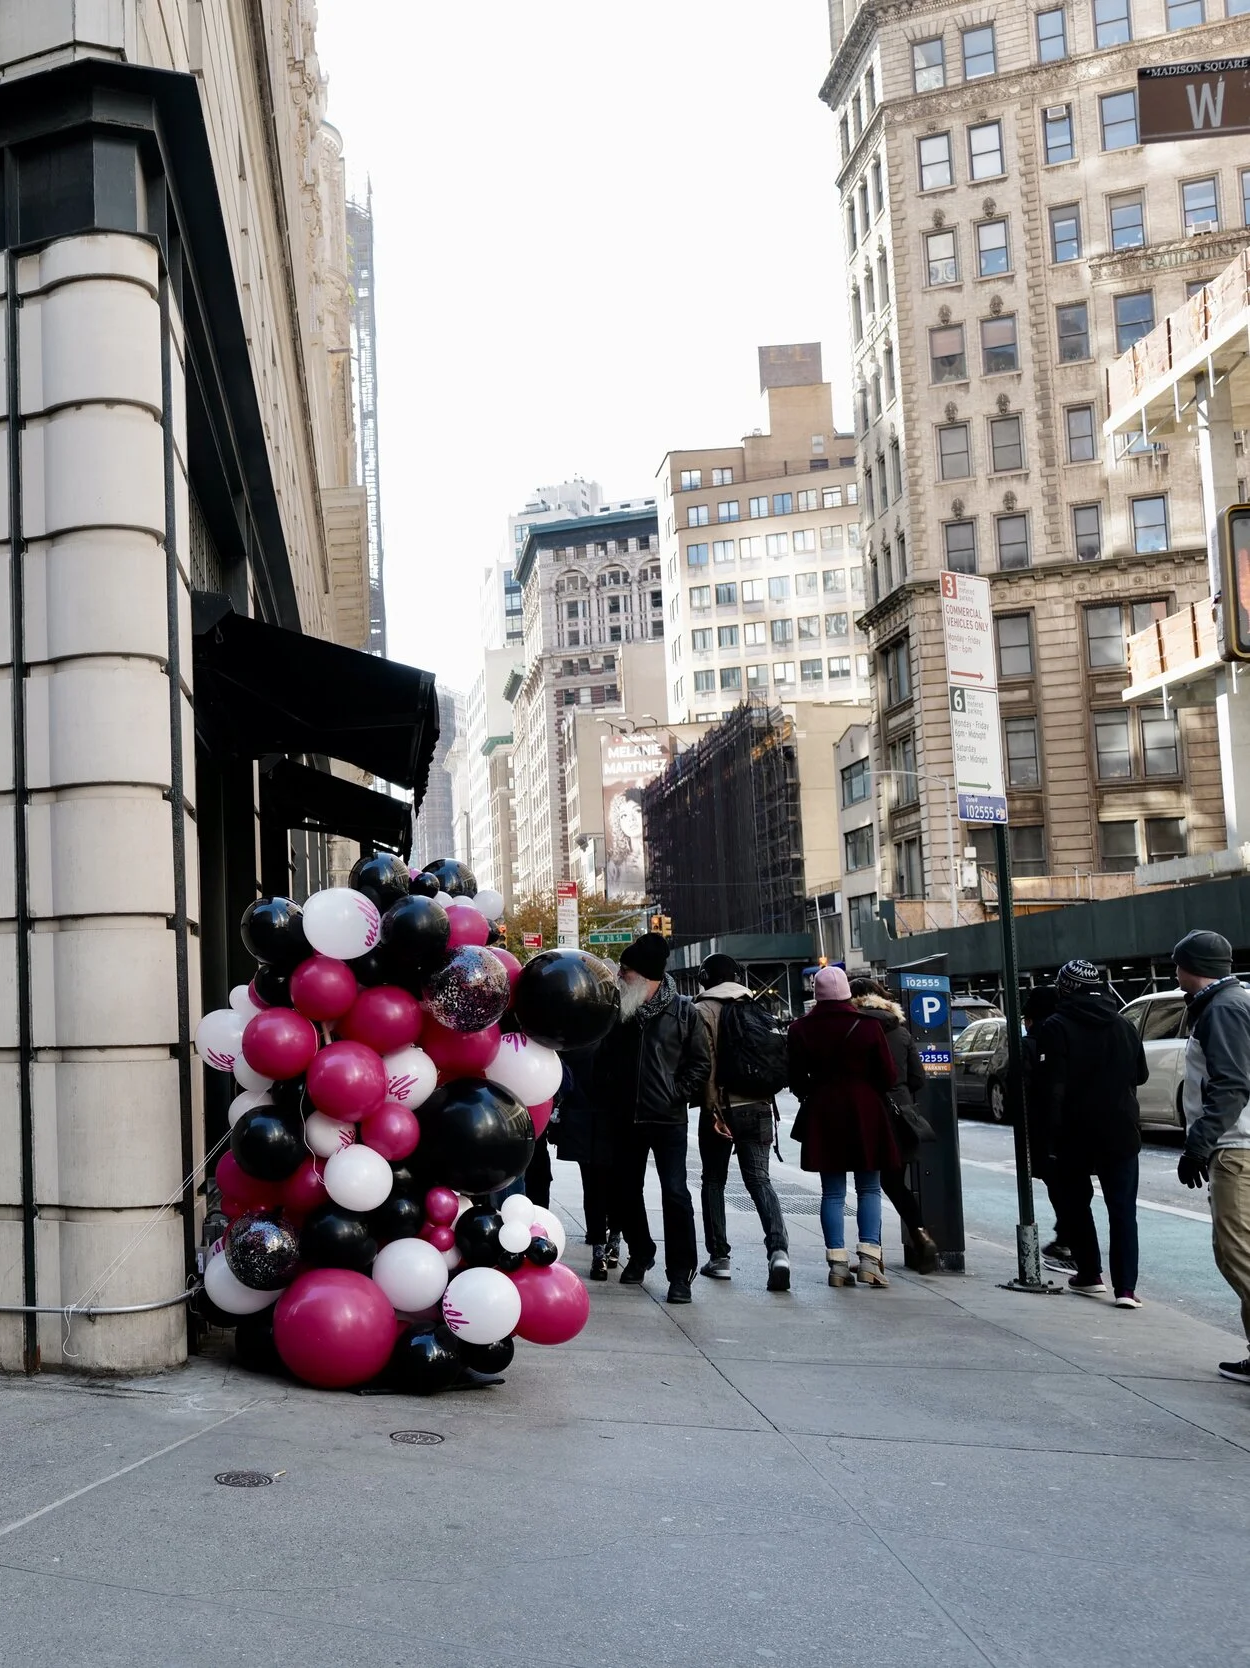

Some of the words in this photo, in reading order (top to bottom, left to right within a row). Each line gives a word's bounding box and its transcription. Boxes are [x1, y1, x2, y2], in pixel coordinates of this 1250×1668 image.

[1151, 64, 1202, 77] MADISON
[1204, 59, 1248, 72] SQUARE
[1186, 80, 1225, 129] W
[945, 575, 954, 597] 3
[945, 604, 982, 620] COMMERCIAL
[946, 617, 974, 630] VEHICLES
[974, 621, 989, 632] ONLY
[953, 689, 963, 711] 6
[608, 744, 662, 759] MELANIE
[604, 759, 667, 774] MARTINEZ
[966, 805, 995, 819] 102555
[906, 978, 940, 987] 102555
[922, 997, 941, 1023] P
